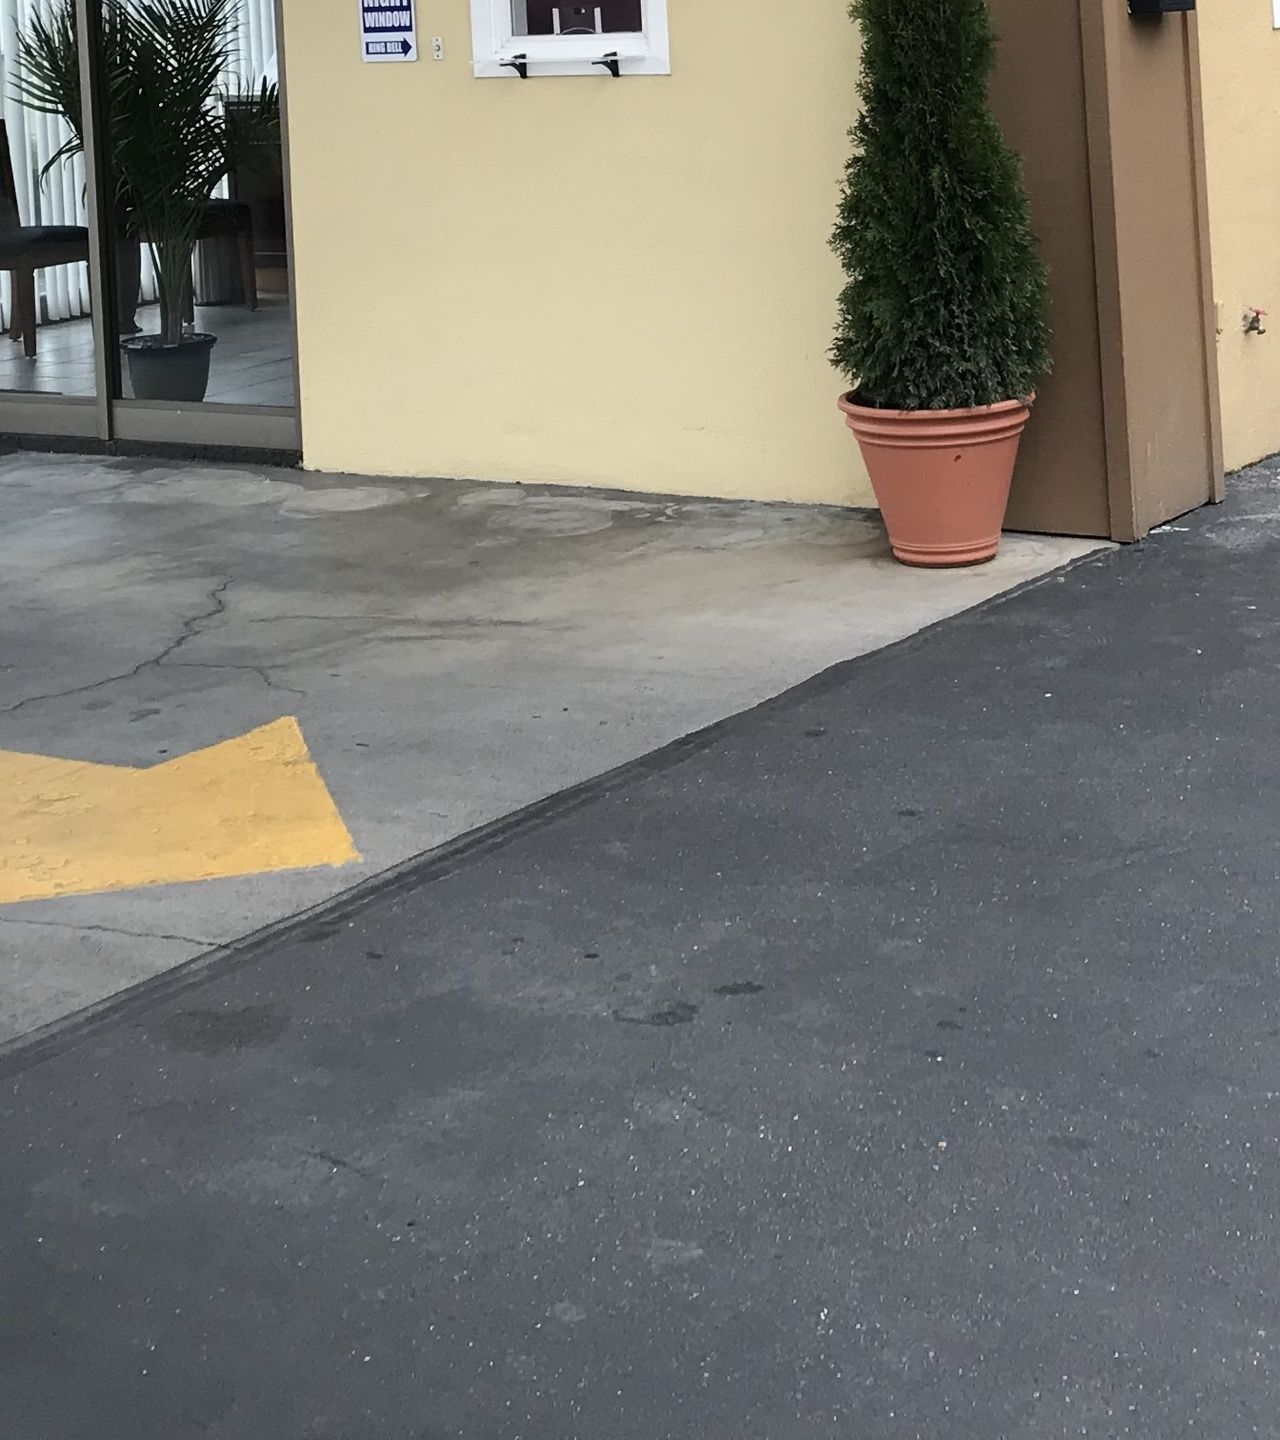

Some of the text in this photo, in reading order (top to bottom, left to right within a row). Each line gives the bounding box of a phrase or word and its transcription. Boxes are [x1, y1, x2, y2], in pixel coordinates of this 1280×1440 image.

[364, 11, 411, 28] WINDOW
[368, 42, 403, 54] RING BELL
